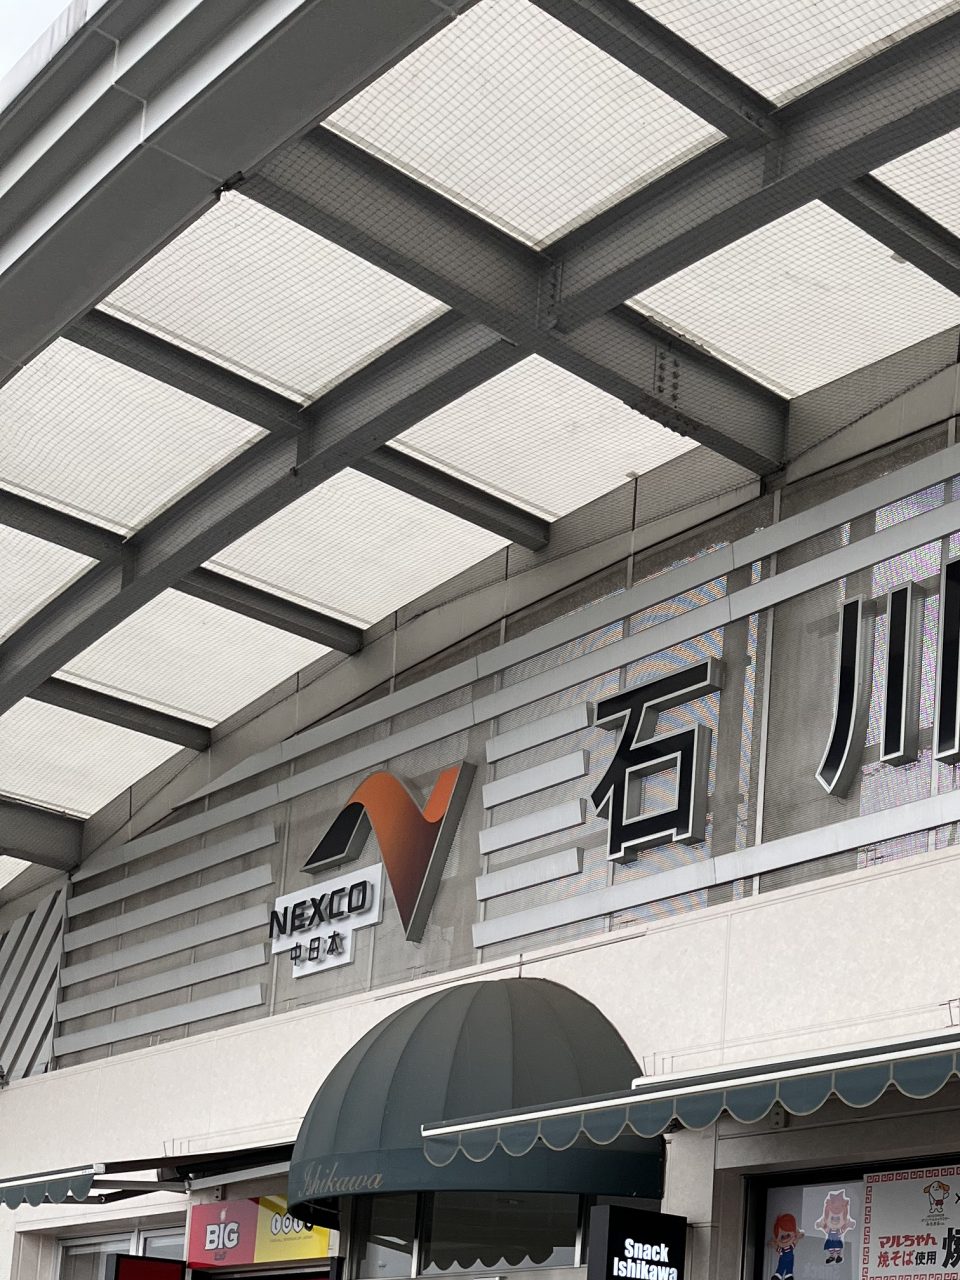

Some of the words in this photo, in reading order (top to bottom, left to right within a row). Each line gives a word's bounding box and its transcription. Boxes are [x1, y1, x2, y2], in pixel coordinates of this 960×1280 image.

[269, 880, 371, 938] NEXCO
[290, 931, 343, 966] 中日本
[299, 1161, 384, 1196] Ishikawa
[205, 1221, 240, 1251] BIG
[624, 1238, 669, 1263] Snack
[878, 1233, 938, 1249] マルちゃん
[877, 1250, 937, 1269] 焼そば使用
